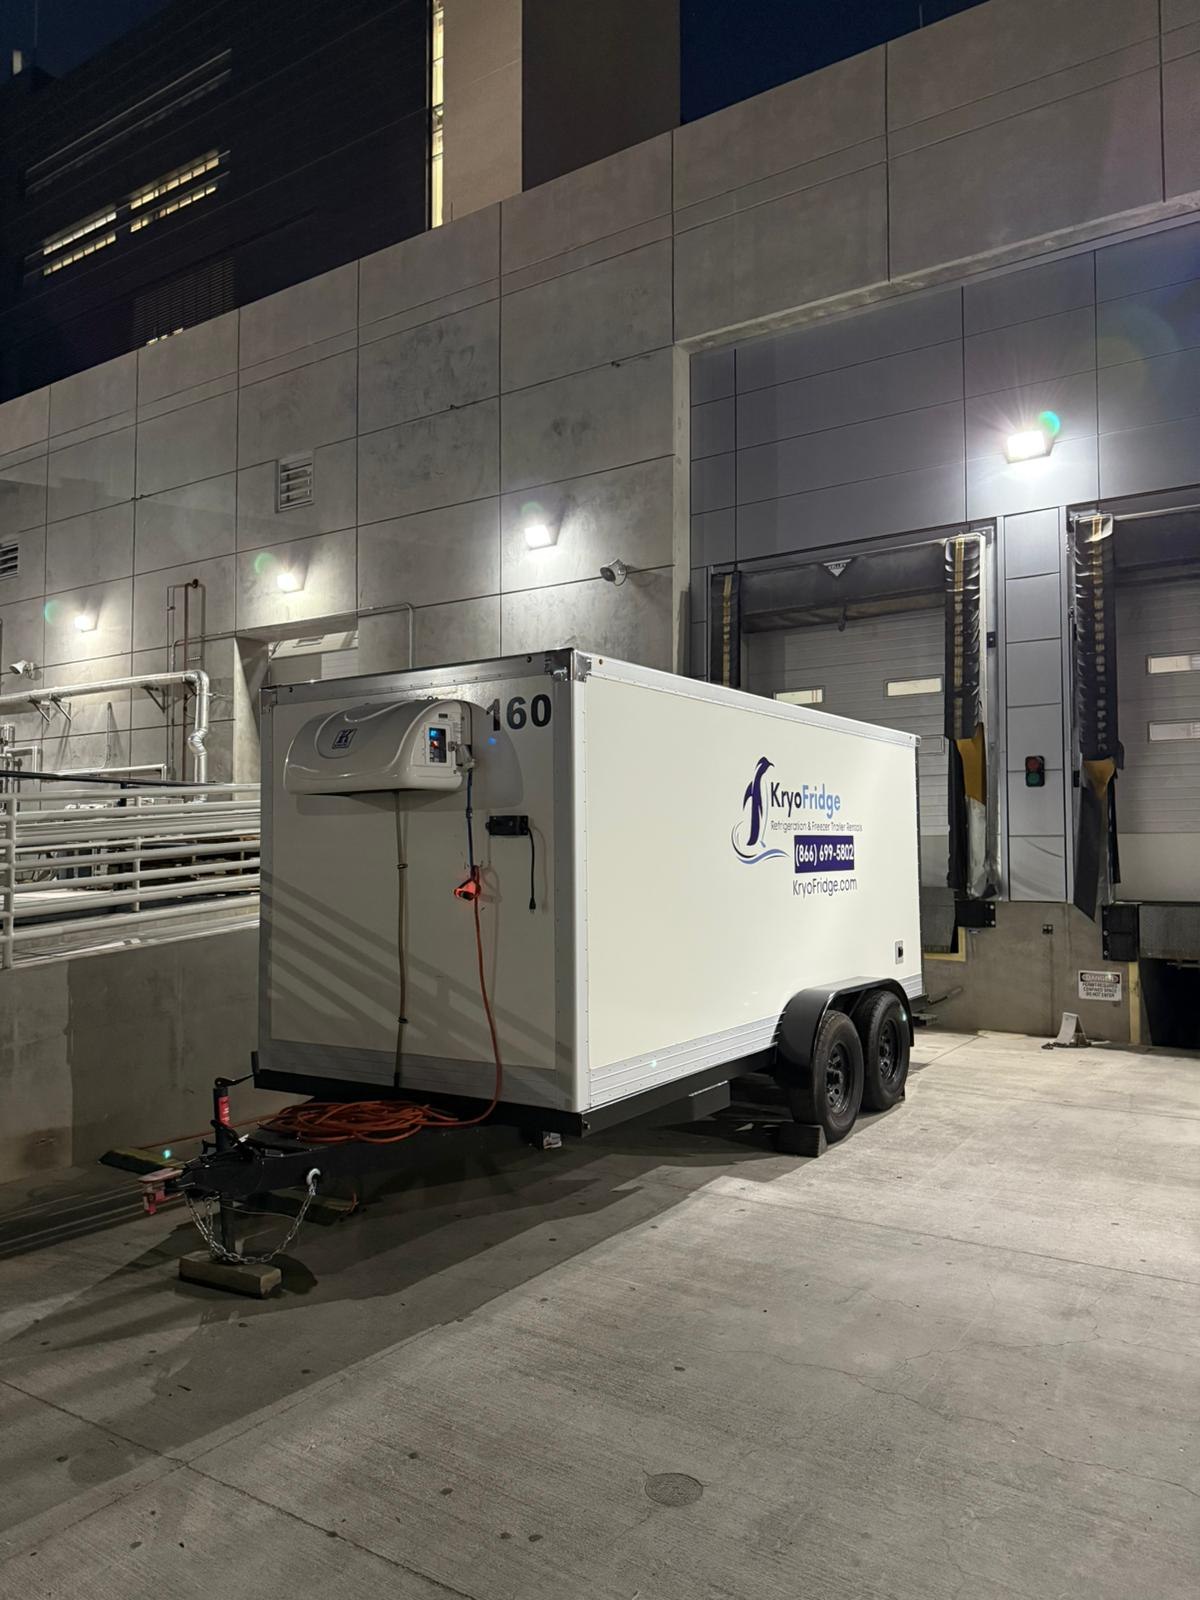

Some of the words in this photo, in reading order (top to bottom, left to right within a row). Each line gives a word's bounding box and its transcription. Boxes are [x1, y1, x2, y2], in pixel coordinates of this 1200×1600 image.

[486, 694, 552, 731] 160
[771, 782, 841, 819] KryoFridge
[770, 820, 806, 833] Refrigeration
[807, 822, 811, 831] &
[812, 821, 830, 832] Freezer
[795, 843, 817, 866] (866)
[819, 844, 854, 861] 699-5802
[793, 877, 857, 898] KryoFridge.com
